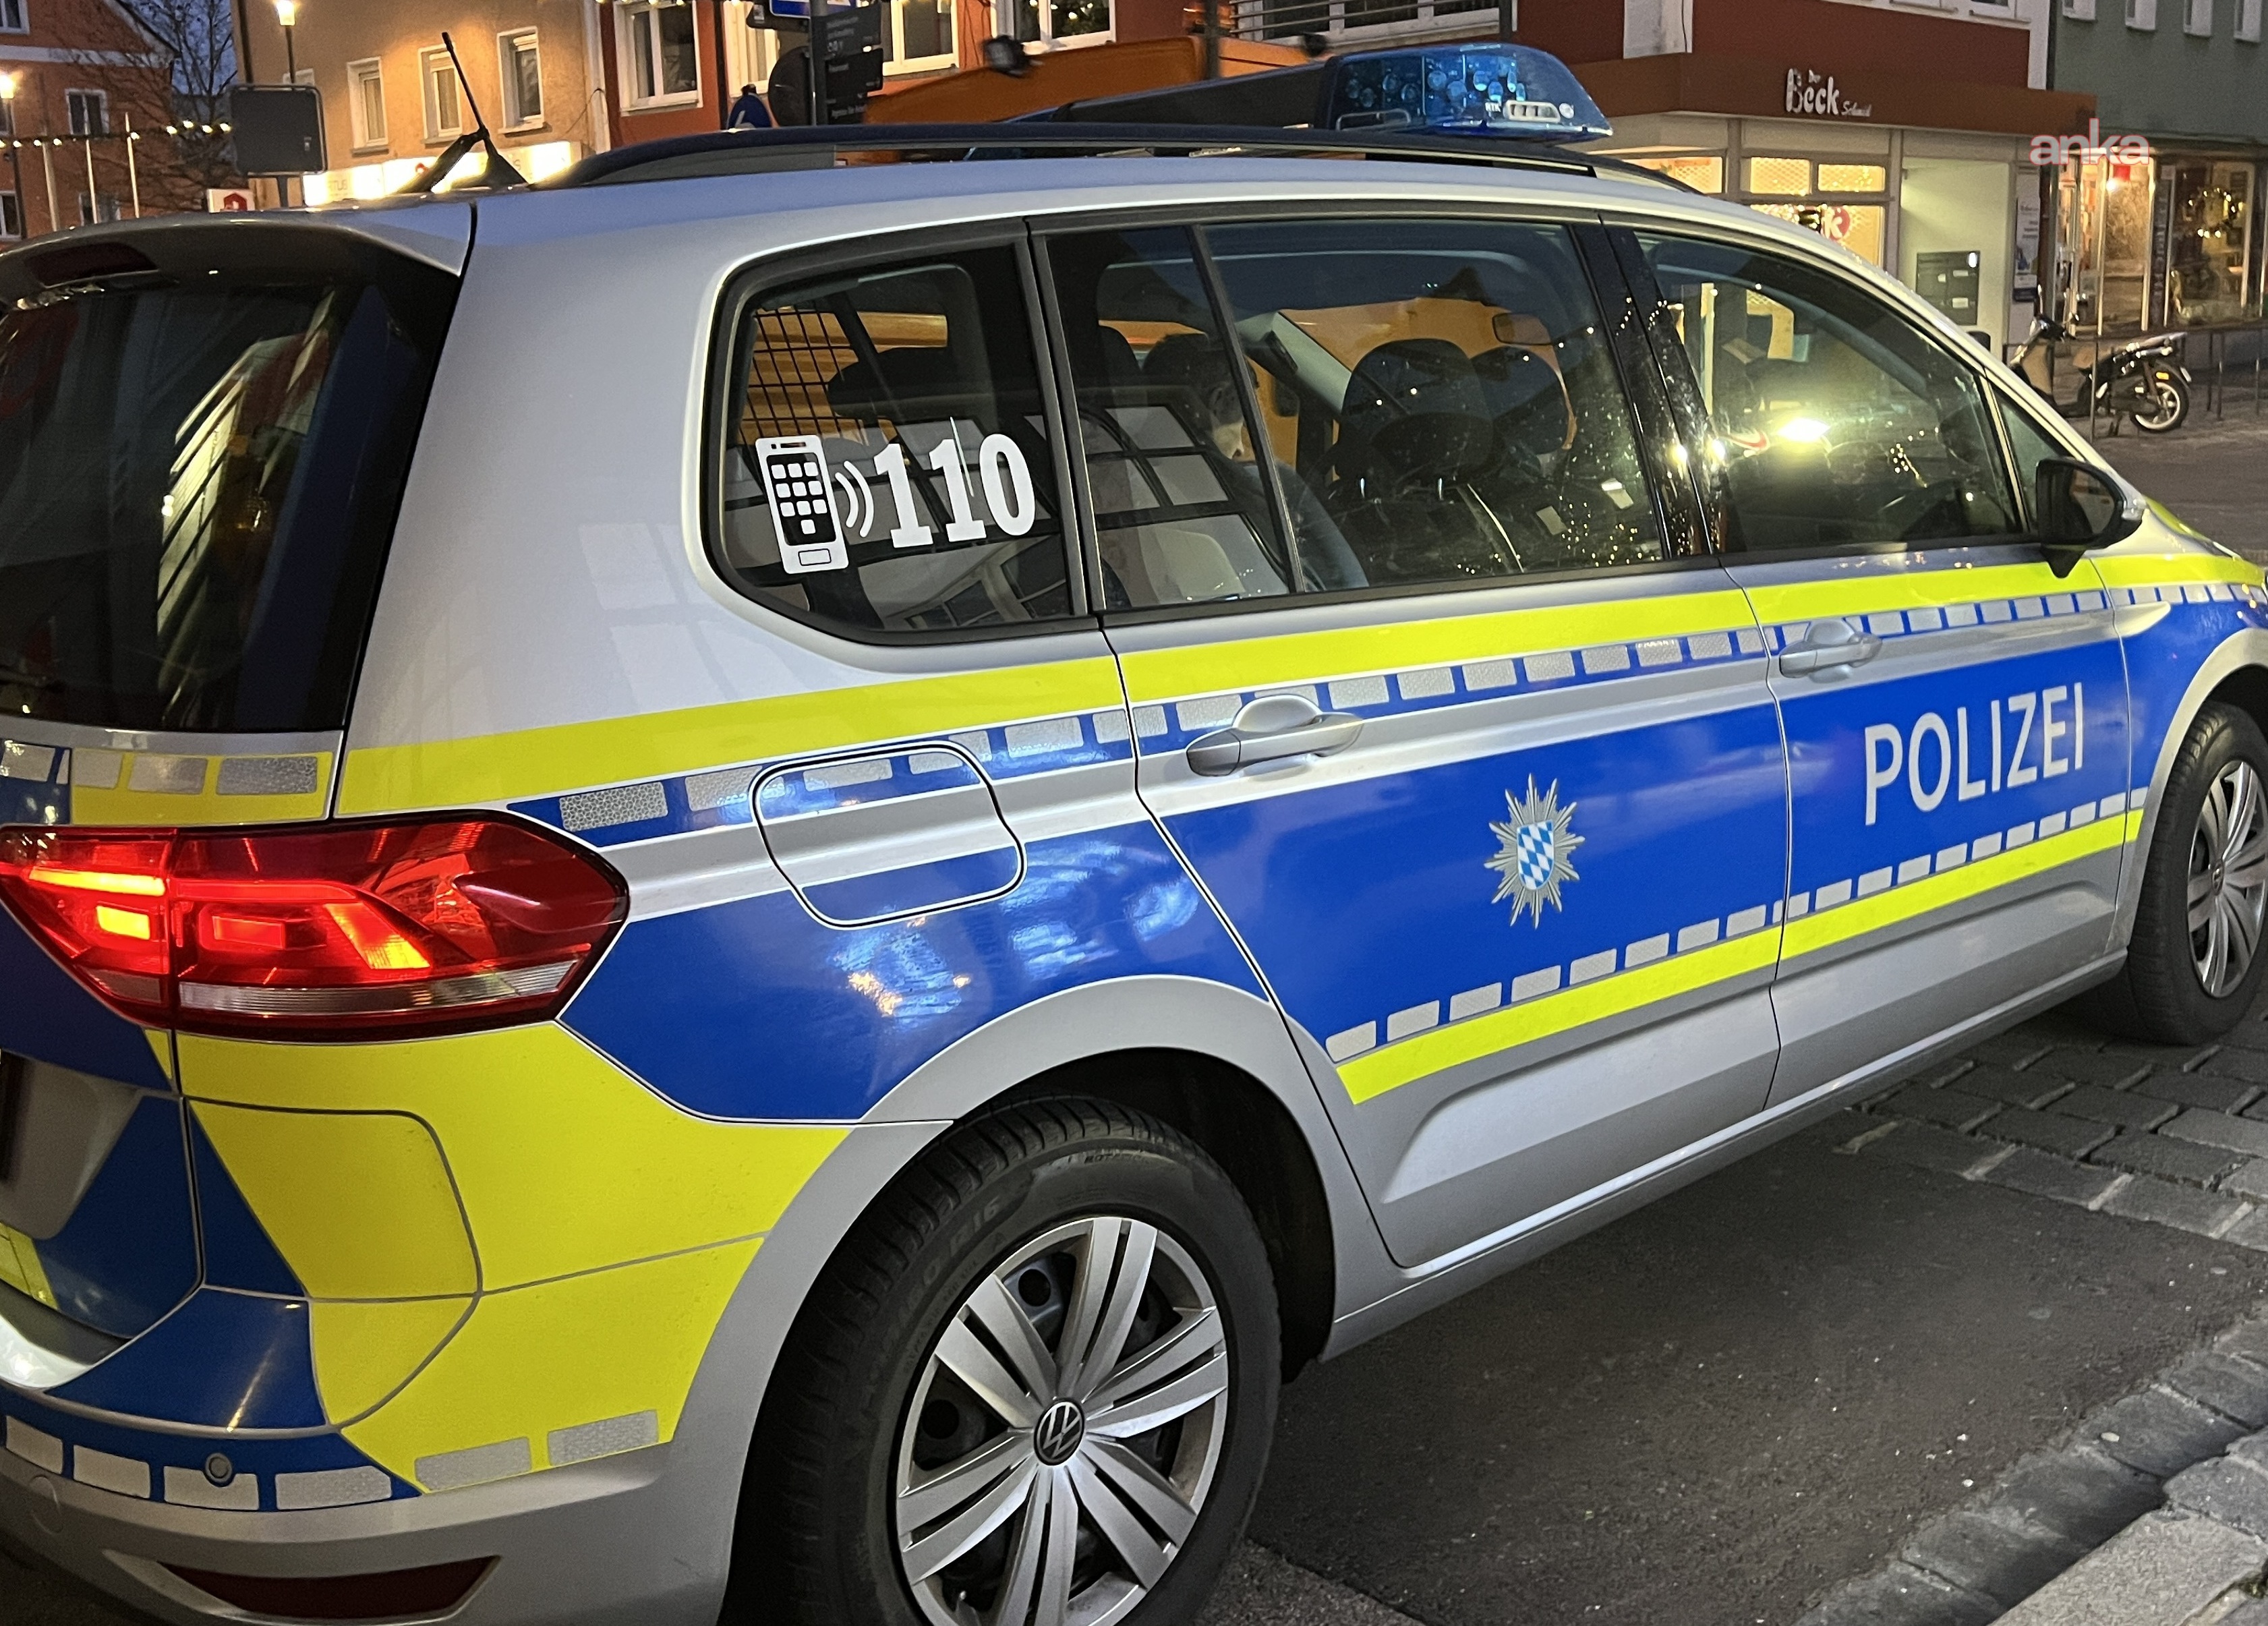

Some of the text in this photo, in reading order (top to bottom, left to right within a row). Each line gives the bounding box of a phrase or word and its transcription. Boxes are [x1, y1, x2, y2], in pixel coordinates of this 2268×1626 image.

[1786, 68, 1839, 115] Beck
[873, 433, 1036, 549] 110
[1864, 682, 2084, 826] POLIZEI
